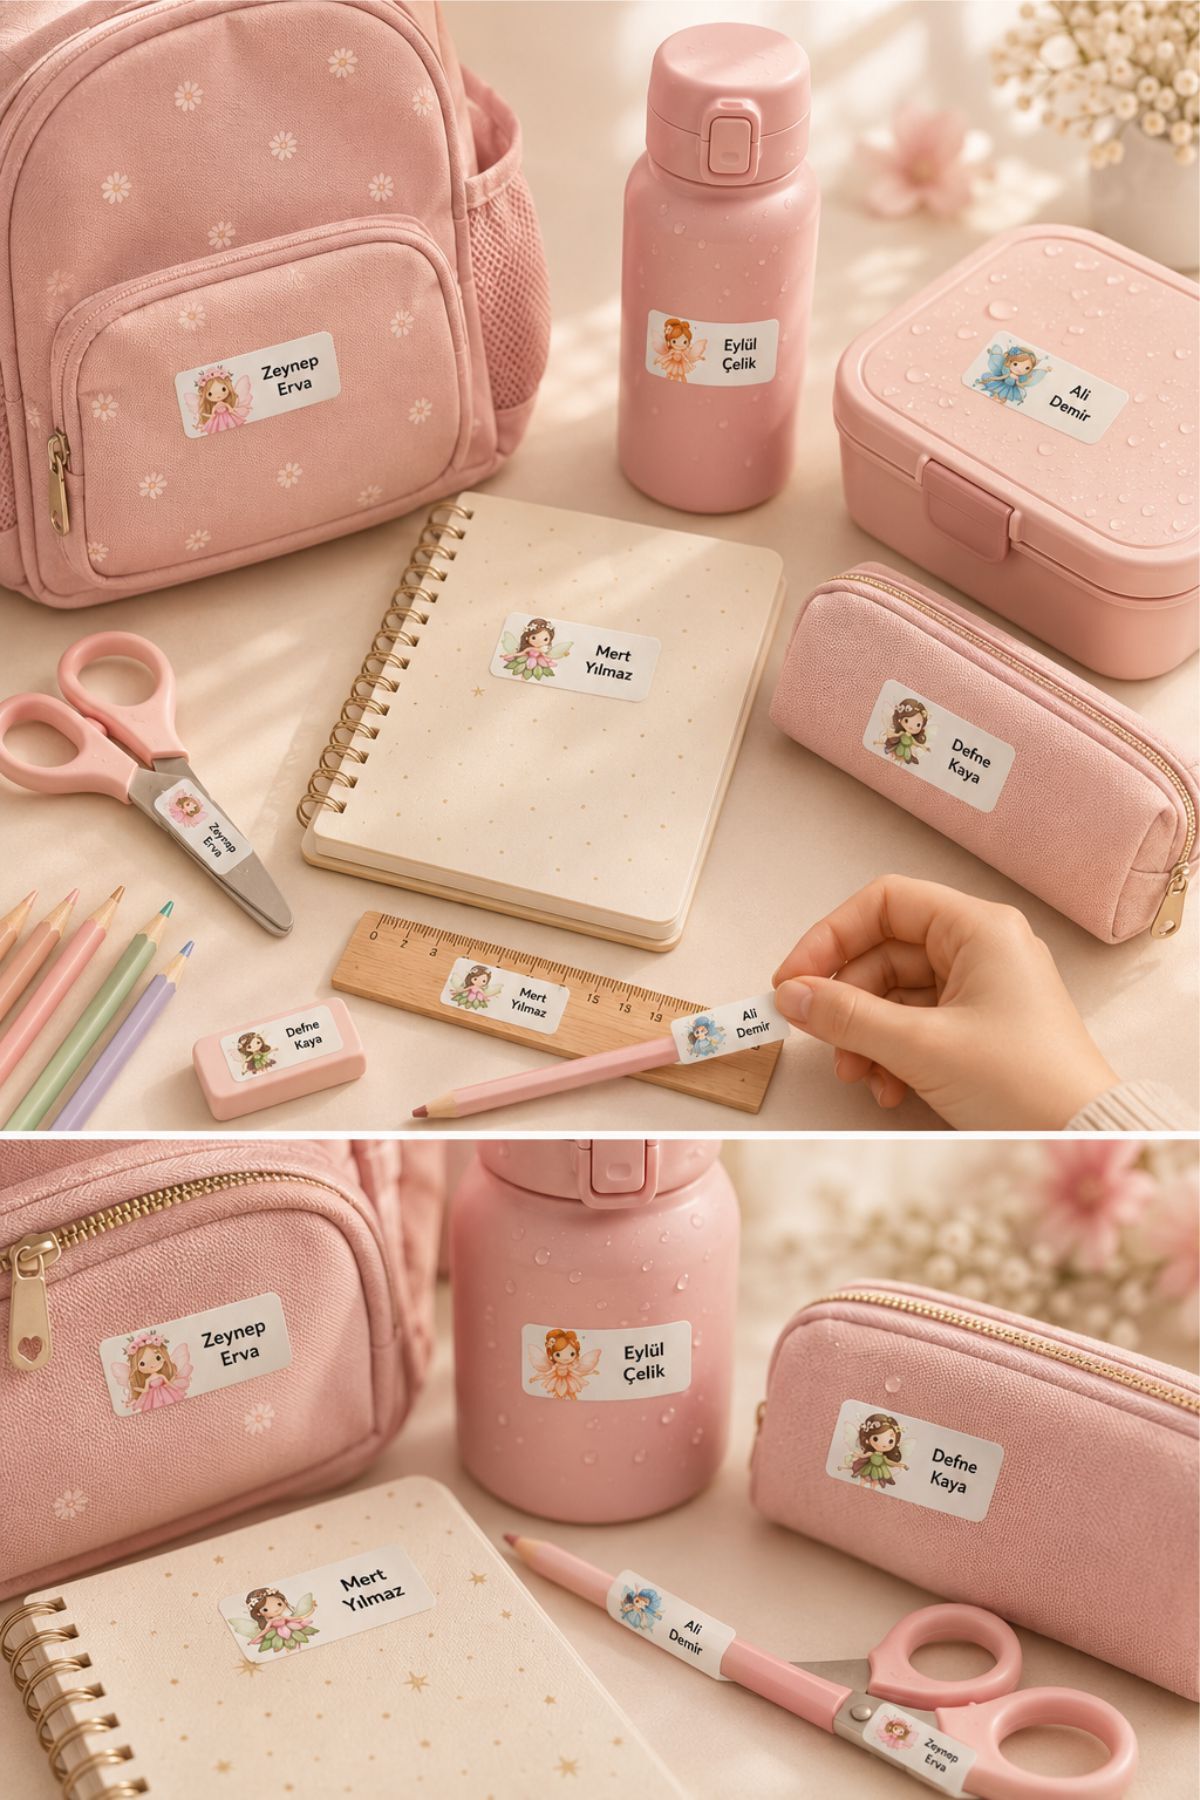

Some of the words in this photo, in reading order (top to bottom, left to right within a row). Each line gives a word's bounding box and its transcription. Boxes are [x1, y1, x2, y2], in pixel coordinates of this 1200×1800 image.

[724, 337, 757, 354] Eylül
[261, 356, 319, 380] Zeynep
[722, 356, 757, 373] Çelik
[277, 379, 312, 396] Erva
[1069, 385, 1091, 401] Ali
[1049, 395, 1091, 421] Demir
[595, 644, 631, 662] Mert
[586, 661, 633, 681] Yılmaz
[951, 738, 991, 768] Defne
[948, 757, 980, 784] Kaya
[519, 987, 547, 1004] Mert
[511, 999, 548, 1018] Yılmaz
[742, 1008, 758, 1021] Ali
[285, 1021, 320, 1038] Defne
[736, 1021, 770, 1039] Demir
[294, 1036, 323, 1050] Kaya
[201, 1322, 266, 1348] Zeynep
[220, 1347, 260, 1366] Erva
[624, 1341, 664, 1363] Eylül
[623, 1363, 666, 1386] Çelik
[932, 1448, 978, 1474] Defne
[930, 1470, 967, 1494] Kaya
[340, 1569, 387, 1592] Mert
[341, 1586, 406, 1612] Yılmaz
[684, 1620, 703, 1635] Ali
[669, 1628, 703, 1656] Demir
[924, 1753, 947, 1773] Erva
